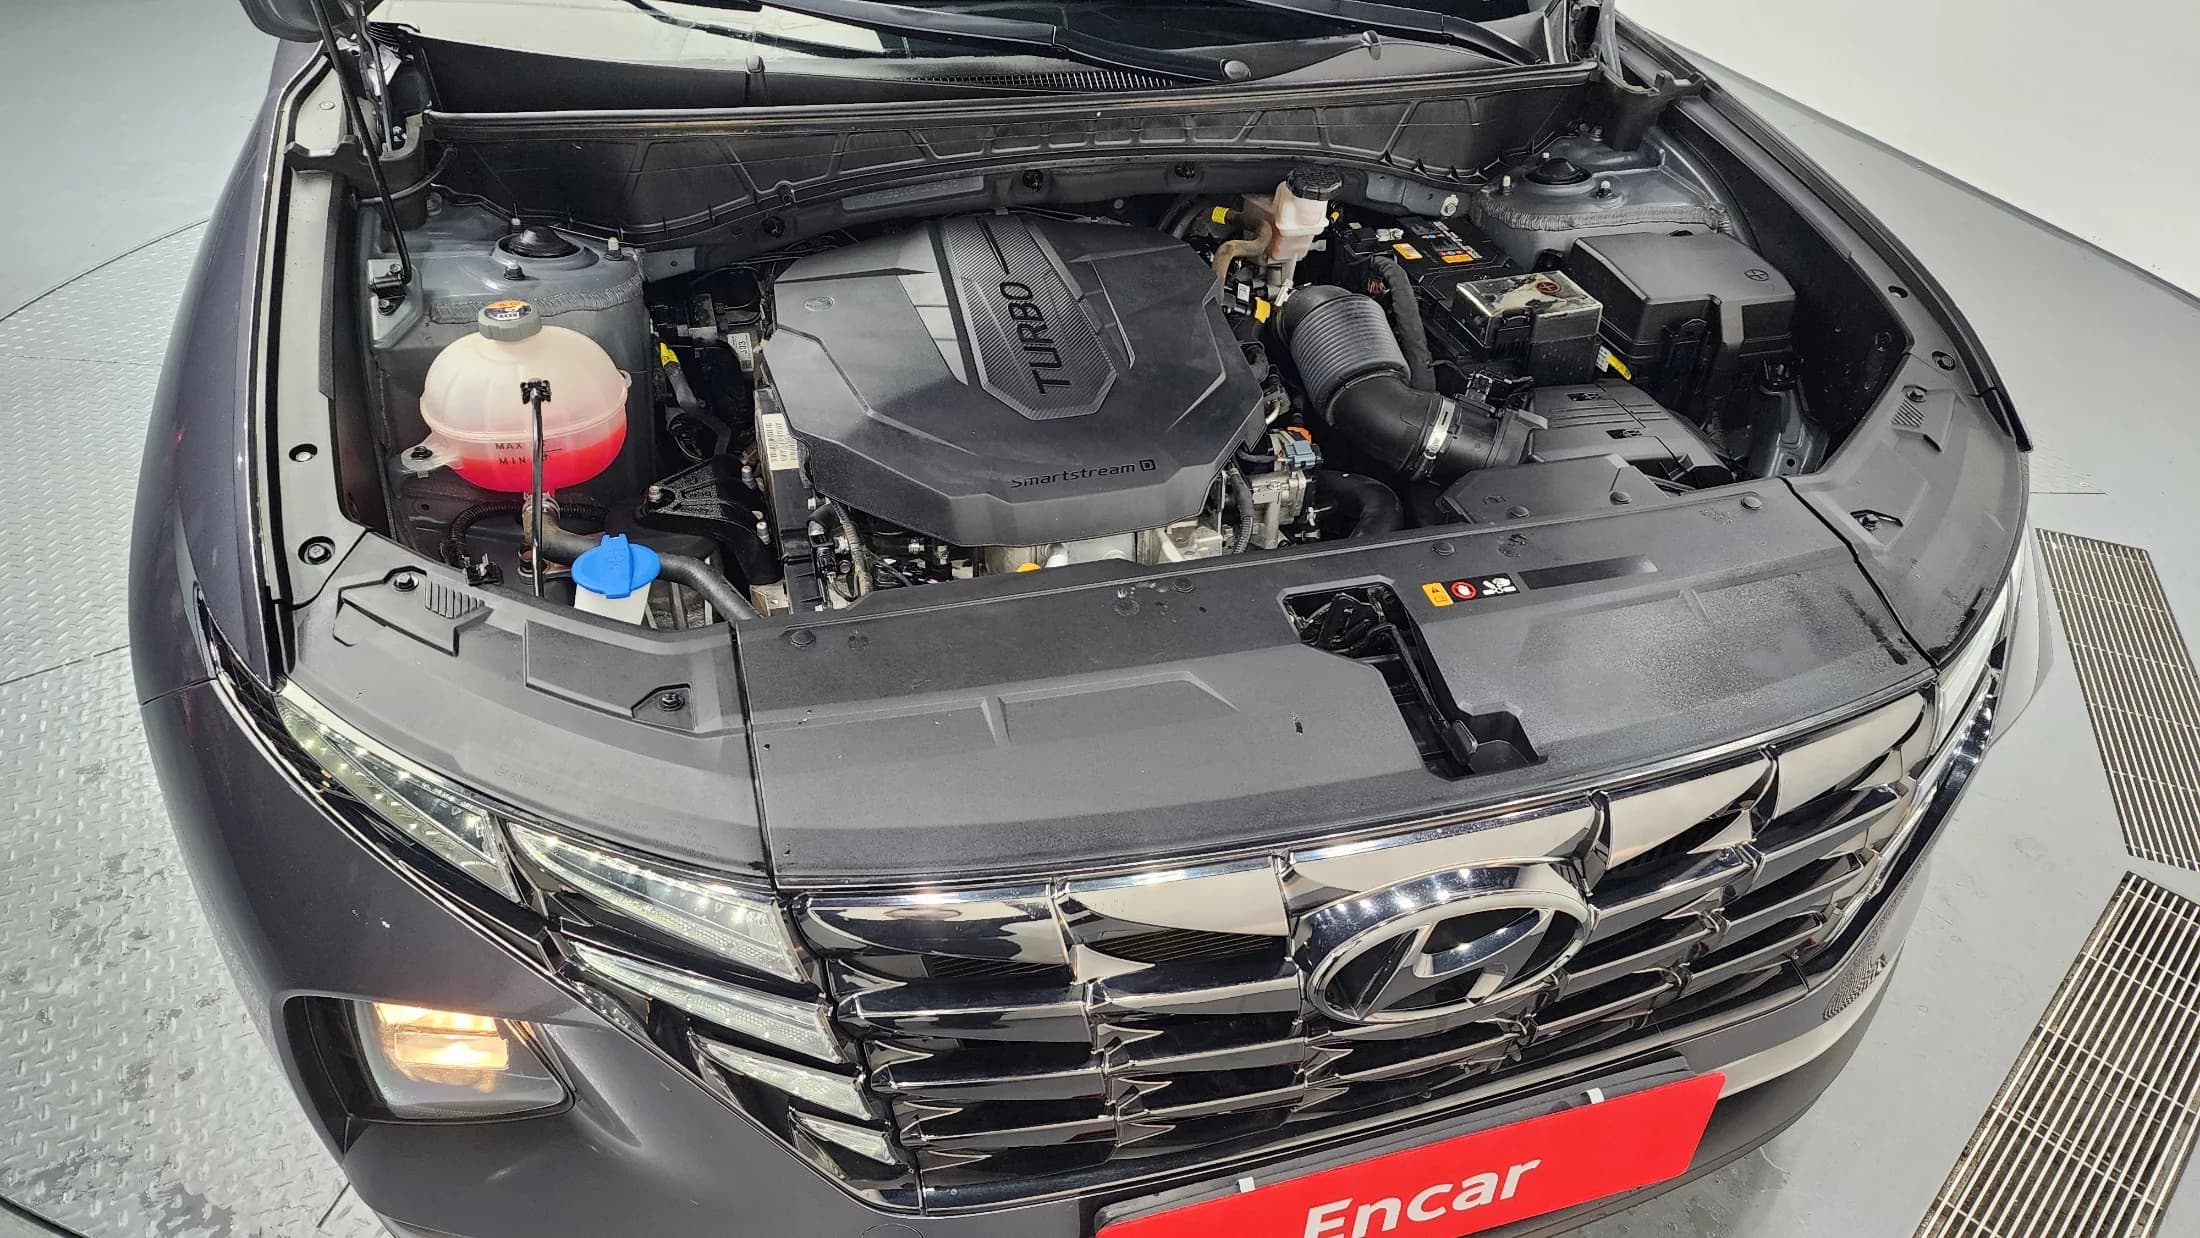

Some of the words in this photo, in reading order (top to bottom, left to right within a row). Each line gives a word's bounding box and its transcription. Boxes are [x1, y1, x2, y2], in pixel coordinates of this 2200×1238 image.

[999, 281, 1071, 395] TURBO
[495, 442, 522, 450] MAX
[498, 456, 526, 465] MIN
[1010, 463, 1135, 488] Smartstream
[1303, 1158, 1542, 1238] Encar
